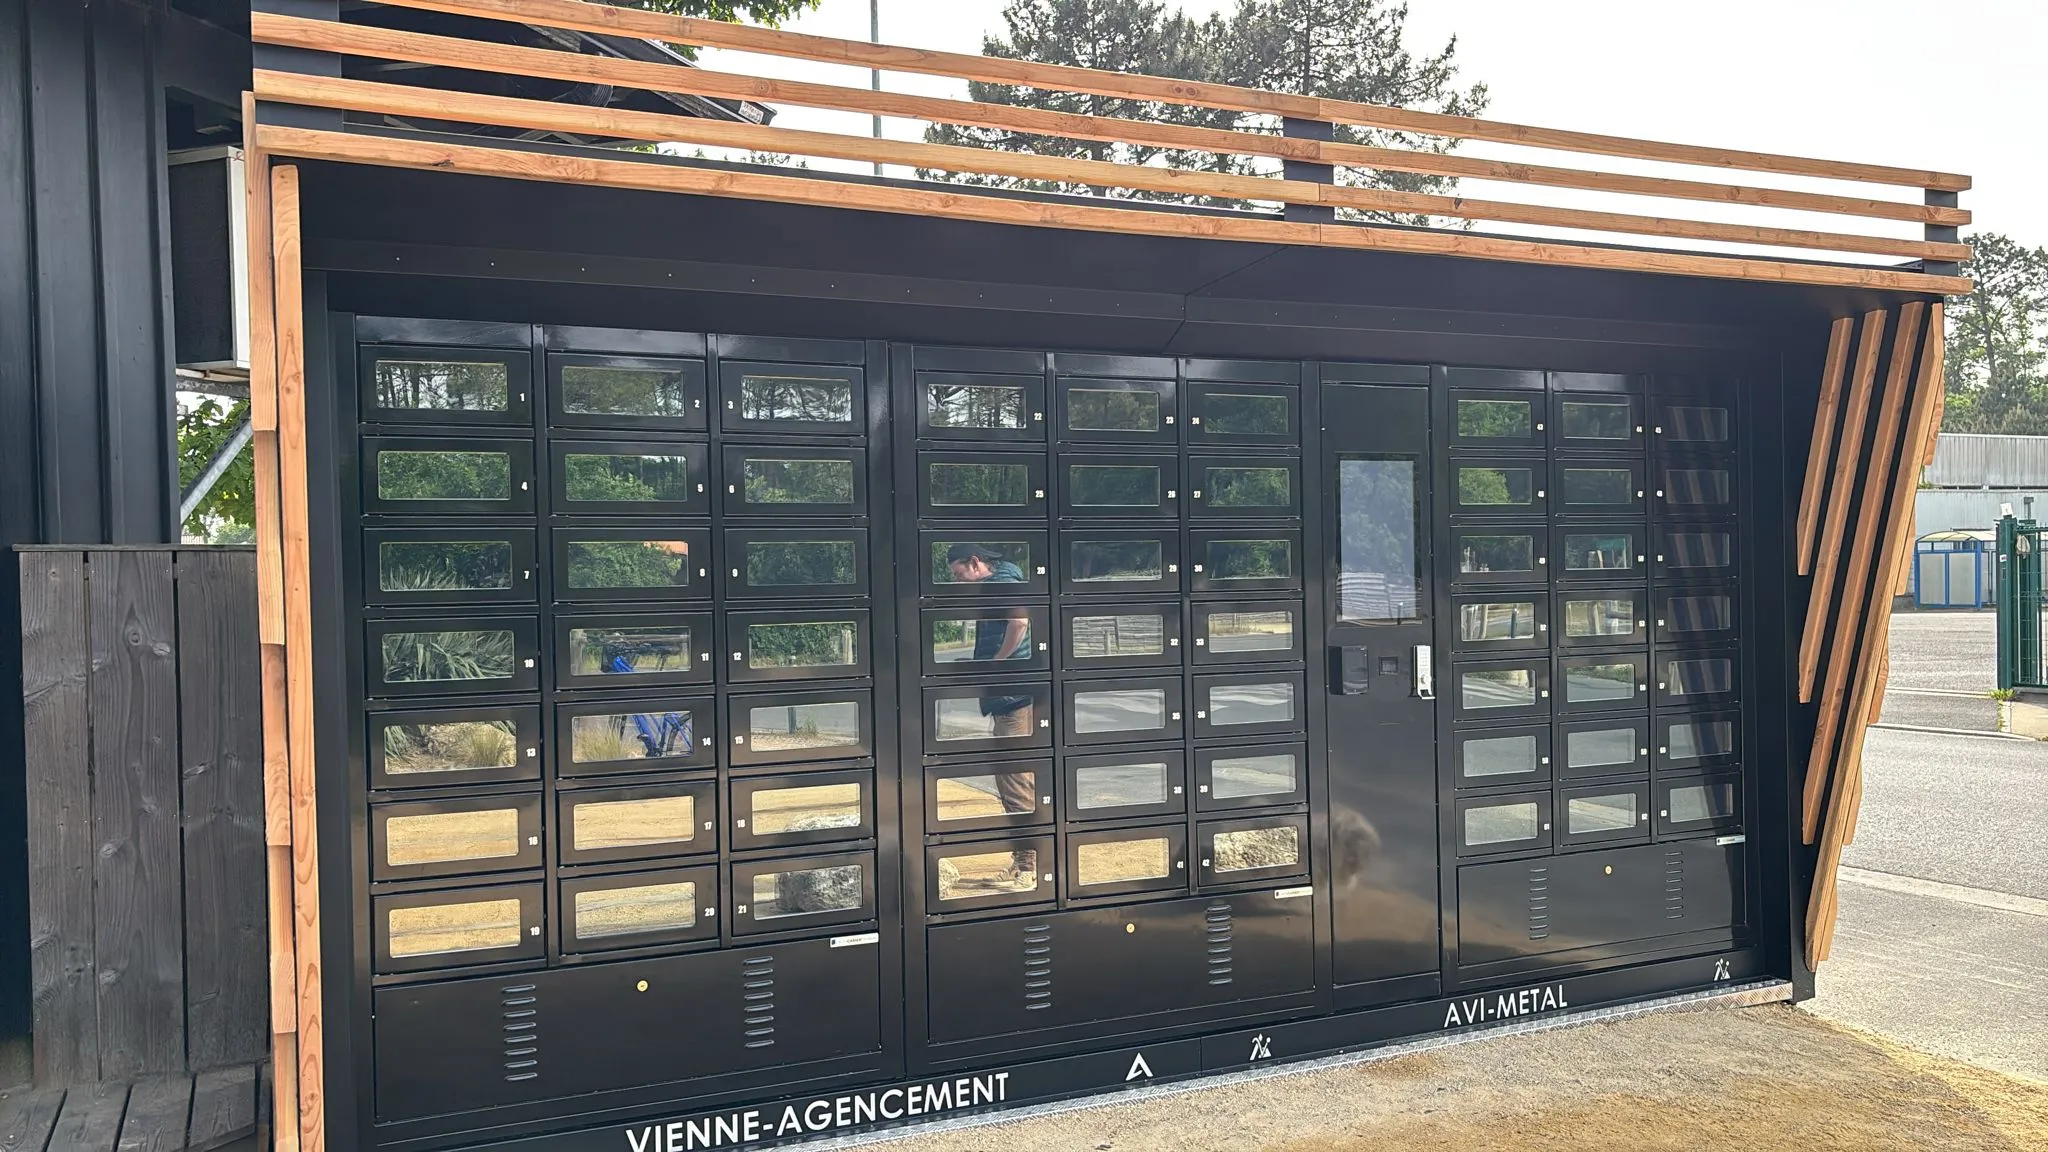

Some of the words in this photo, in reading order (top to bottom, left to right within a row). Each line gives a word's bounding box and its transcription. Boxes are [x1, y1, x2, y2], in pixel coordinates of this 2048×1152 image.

[519, 392, 525, 402] 1
[694, 399, 700, 409] 2
[727, 400, 734, 410] 3
[1033, 412, 1043, 421] 22
[1165, 416, 1174, 425] 23
[521, 481, 528, 491] 4
[697, 483, 704, 493] 5
[728, 484, 735, 494] 6
[1035, 489, 1044, 498] 25
[1192, 490, 1201, 499] 27
[524, 570, 530, 580] 7
[699, 568, 706, 577] 8
[732, 568, 739, 578] 9
[699, 652, 709, 662] 11
[732, 651, 742, 661] 12
[523, 658, 535, 668] 10
[702, 737, 712, 746] 14
[734, 735, 744, 745] 15
[525, 747, 536, 757] 13
[1042, 795, 1051, 805] 37
[703, 821, 713, 831] 17
[736, 819, 746, 828] 18
[528, 836, 538, 846] 16
[704, 907, 715, 917] 20
[737, 904, 747, 914] 21
[529, 926, 540, 936] 19
[1443, 984, 1568, 1028] AVI-METAL
[626, 1072, 1010, 1152] VIENNE-AGENCEMENT
